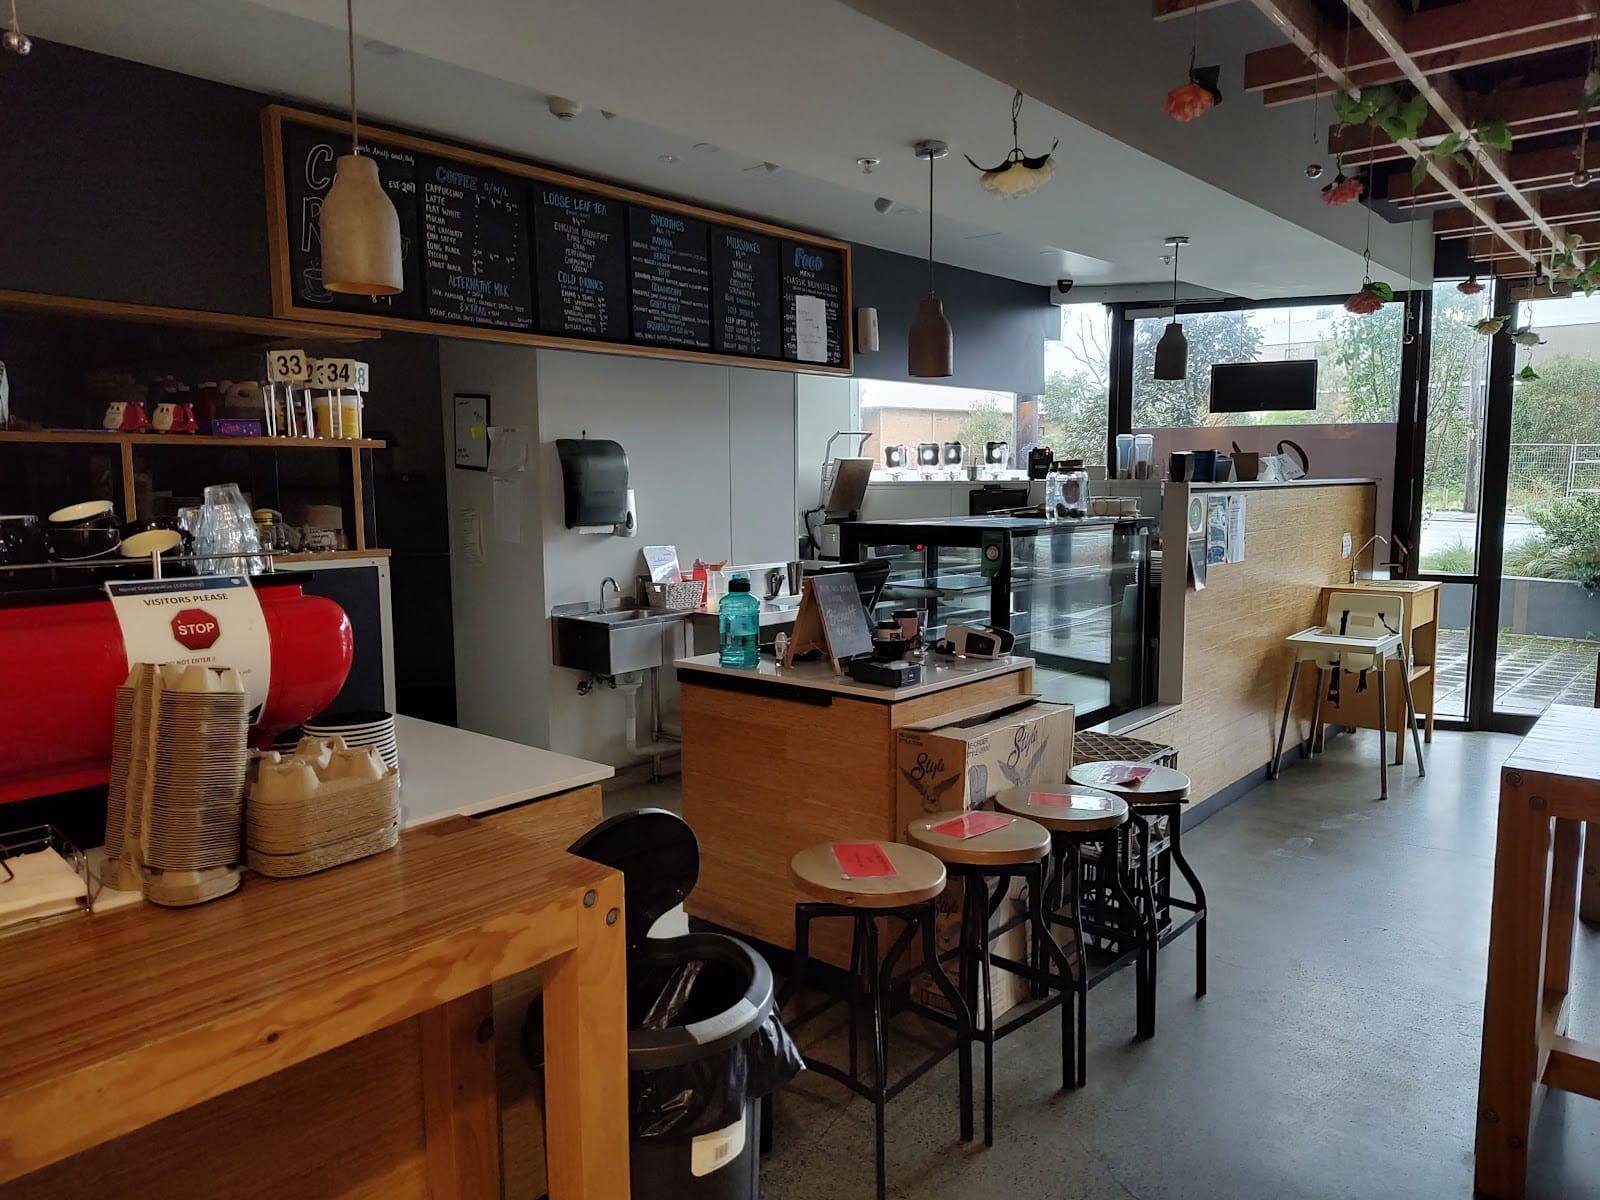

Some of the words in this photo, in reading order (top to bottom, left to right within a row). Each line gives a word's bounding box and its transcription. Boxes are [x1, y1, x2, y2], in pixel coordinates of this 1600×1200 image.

[425, 182, 464, 199] CAPPUCCINO
[425, 193, 446, 206] LATTE
[543, 191, 571, 209] LOOSE
[573, 198, 592, 213] LEAF
[593, 202, 609, 217] TEA
[425, 203, 440, 216] FLAT
[441, 207, 461, 219] WHITE
[425, 213, 446, 225] MOCHA
[554, 221, 579, 235] ENGLISH
[566, 233, 580, 244] EARL
[726, 235, 761, 255] MILKSHAKES
[731, 260, 753, 272] VANILLA
[794, 247, 824, 271] FOOD
[448, 274, 493, 295] ALTERNATIVE
[494, 281, 510, 298] MILK
[557, 270, 577, 286] COLD
[579, 275, 604, 292] DRINKS
[277, 355, 302, 376] 33
[327, 363, 350, 382] 34
[143, 596, 191, 607] VISITORS
[193, 592, 229, 602] PLEASE
[178, 622, 215, 636] STOP
[191, 656, 211, 665] ENTER
[1006, 722, 1038, 770] Style
[911, 752, 945, 781] Style
